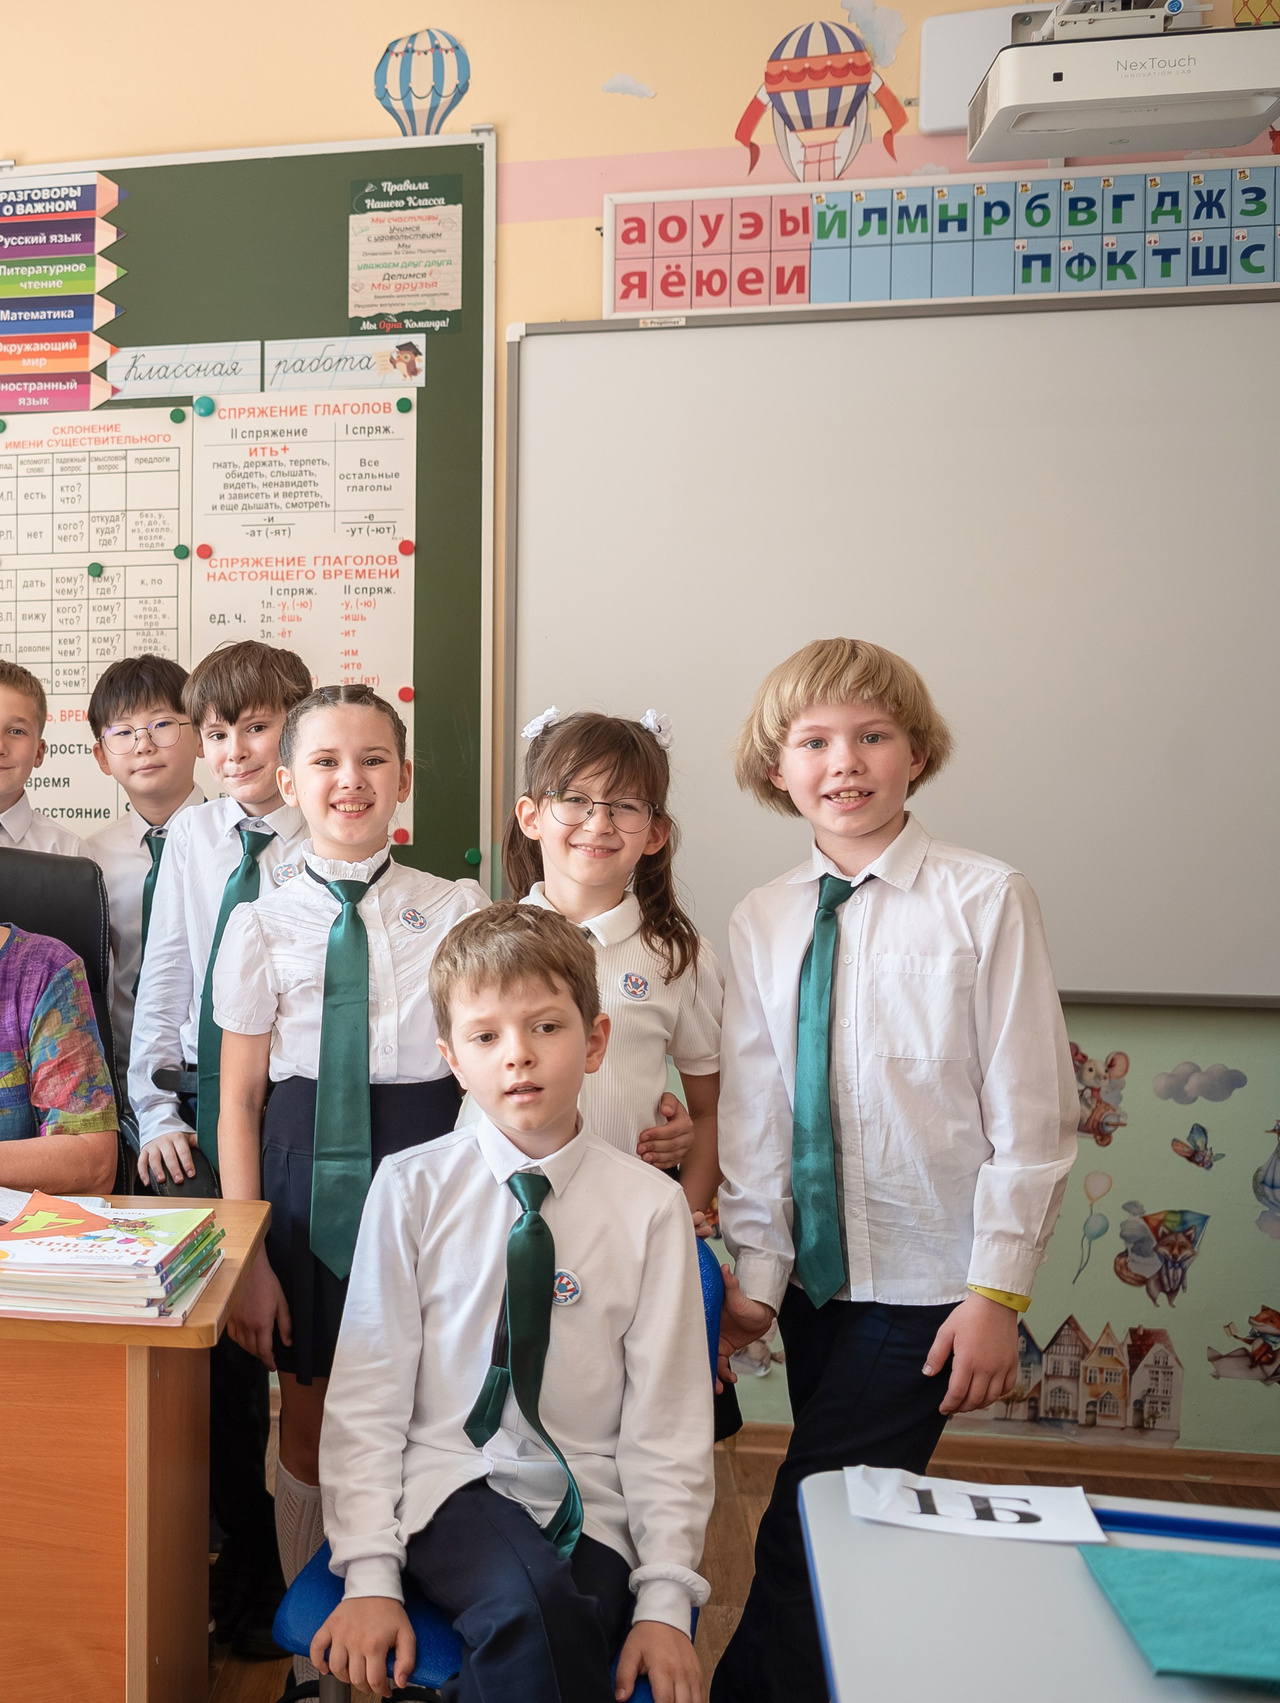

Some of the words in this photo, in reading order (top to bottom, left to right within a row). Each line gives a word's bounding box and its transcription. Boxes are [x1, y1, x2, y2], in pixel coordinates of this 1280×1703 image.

[1117, 55, 1197, 71] NexTouch
[1121, 71, 1172, 79] INNOVATION
[381, 179, 429, 195] Правила
[0, 187, 82, 203] РАЗГОВОРЫ
[2, 205, 13, 216] О
[16, 200, 77, 215] ВАЖНОМ
[365, 199, 406, 209] Нашего
[406, 196, 445, 207] Класса
[388, 214, 440, 223] счастливы
[621, 218, 646, 245] а
[658, 216, 687, 243] о
[700, 214, 724, 248] у
[738, 212, 764, 240] э
[779, 207, 810, 236] ы
[818, 204, 847, 240] й
[858, 207, 888, 237] л
[897, 205, 929, 234] м
[938, 203, 967, 233] н
[983, 201, 1010, 235] р
[1025, 192, 1051, 227] б
[1069, 196, 1098, 226] в
[1112, 194, 1135, 224] г
[1151, 191, 1182, 224] д
[1193, 189, 1227, 220] ж
[1240, 187, 1267, 216] з
[389, 226, 420, 234] Учимся
[50, 233, 82, 244] язык
[383, 272, 427, 282] Делимся
[620, 272, 647, 299] я
[660, 264, 686, 297] ё
[696, 268, 727, 297] ю
[737, 268, 764, 295] е
[776, 266, 806, 295] и
[1022, 254, 1052, 283] п
[1065, 252, 1097, 282] ф
[1107, 250, 1138, 281] к
[1152, 248, 1181, 278] т
[1191, 245, 1228, 277] ш
[1240, 244, 1266, 274] с
[21, 279, 63, 290] чтение
[371, 283, 391, 291] Мы
[395, 281, 438, 292] друзья
[0, 310, 74, 322] Математика
[360, 321, 377, 330] Мы
[379, 320, 402, 333] Одна
[404, 317, 450, 331] Команда!
[22, 358, 47, 368] мир
[124, 354, 243, 382] Классная
[270, 344, 376, 386] работа
[18, 397, 50, 406] язык
[218, 405, 308, 420] СПРЯЖЕНИЕ
[315, 402, 392, 416] ГЛАГОЛОВ
[52, 424, 122, 436] СКЛОНЕНИЕ
[241, 428, 308, 440] спряжение
[352, 425, 394, 437] спряж.
[5, 440, 44, 450] ИМЕНИ
[47, 434, 172, 448] СУЩЕСТВИТЕЛЬНОГО
[55, 456, 87, 464] падежный
[90, 454, 126, 462] смысловой
[135, 456, 171, 465] предлоги
[360, 459, 380, 467] Все
[60, 465, 82, 473] вопрос
[213, 461, 241, 470] гнать,
[243, 460, 286, 470] держать,
[289, 458, 330, 468] терпеть,
[225, 469, 268, 480] обидеть,
[270, 469, 317, 478] слышать,
[339, 471, 400, 480] остальные
[60, 483, 82, 493] кто?
[224, 482, 260, 490] видеть,
[263, 480, 319, 489] ненавидеть
[347, 483, 392, 493] глаголы
[24, 492, 47, 501] есть
[60, 494, 82, 505] что?
[228, 491, 270, 500] зависеть
[283, 490, 323, 500] вертеть,
[220, 503, 239, 512] еще
[241, 502, 283, 512] дышать,
[285, 501, 331, 511] смотреть
[91, 512, 126, 525] откуда?
[58, 521, 84, 531] кого?
[96, 524, 121, 536] куда?
[27, 531, 44, 539] нет
[57, 532, 84, 543] чего?
[99, 536, 118, 547] где?
[208, 557, 306, 569] СПРЯЖЕНИЕ
[314, 555, 398, 567] ГЛАГОЛОВ
[55, 574, 84, 585] кому?
[207, 569, 316, 582] НАСТОЯЩЕГО
[323, 569, 400, 580] ВРЕМЕНИ
[22, 579, 46, 589] дать
[55, 586, 84, 596] чему?
[96, 585, 117, 596] где?
[277, 587, 317, 597] спряж.
[354, 586, 396, 596] спряж.
[57, 604, 83, 615] кого?
[92, 602, 121, 613] кому?
[22, 613, 47, 622] вижу
[59, 616, 80, 626] что?
[96, 614, 117, 625] где?
[210, 613, 230, 626] ед.
[235, 614, 246, 624] ч.
[341, 613, 366, 622] -ишь
[341, 629, 356, 638] -ит
[58, 636, 81, 646] кем?
[92, 634, 121, 645] кому?
[19, 645, 50, 654] доволен
[58, 647, 81, 657] чем?
[96, 646, 117, 656] где?
[63, 666, 86, 677] ком?
[63, 677, 86, 689] чем?
[60, 710, 88, 722] ВРЕМ
[26, 777, 70, 791] время
[10, 1211, 86, 1233] 4
